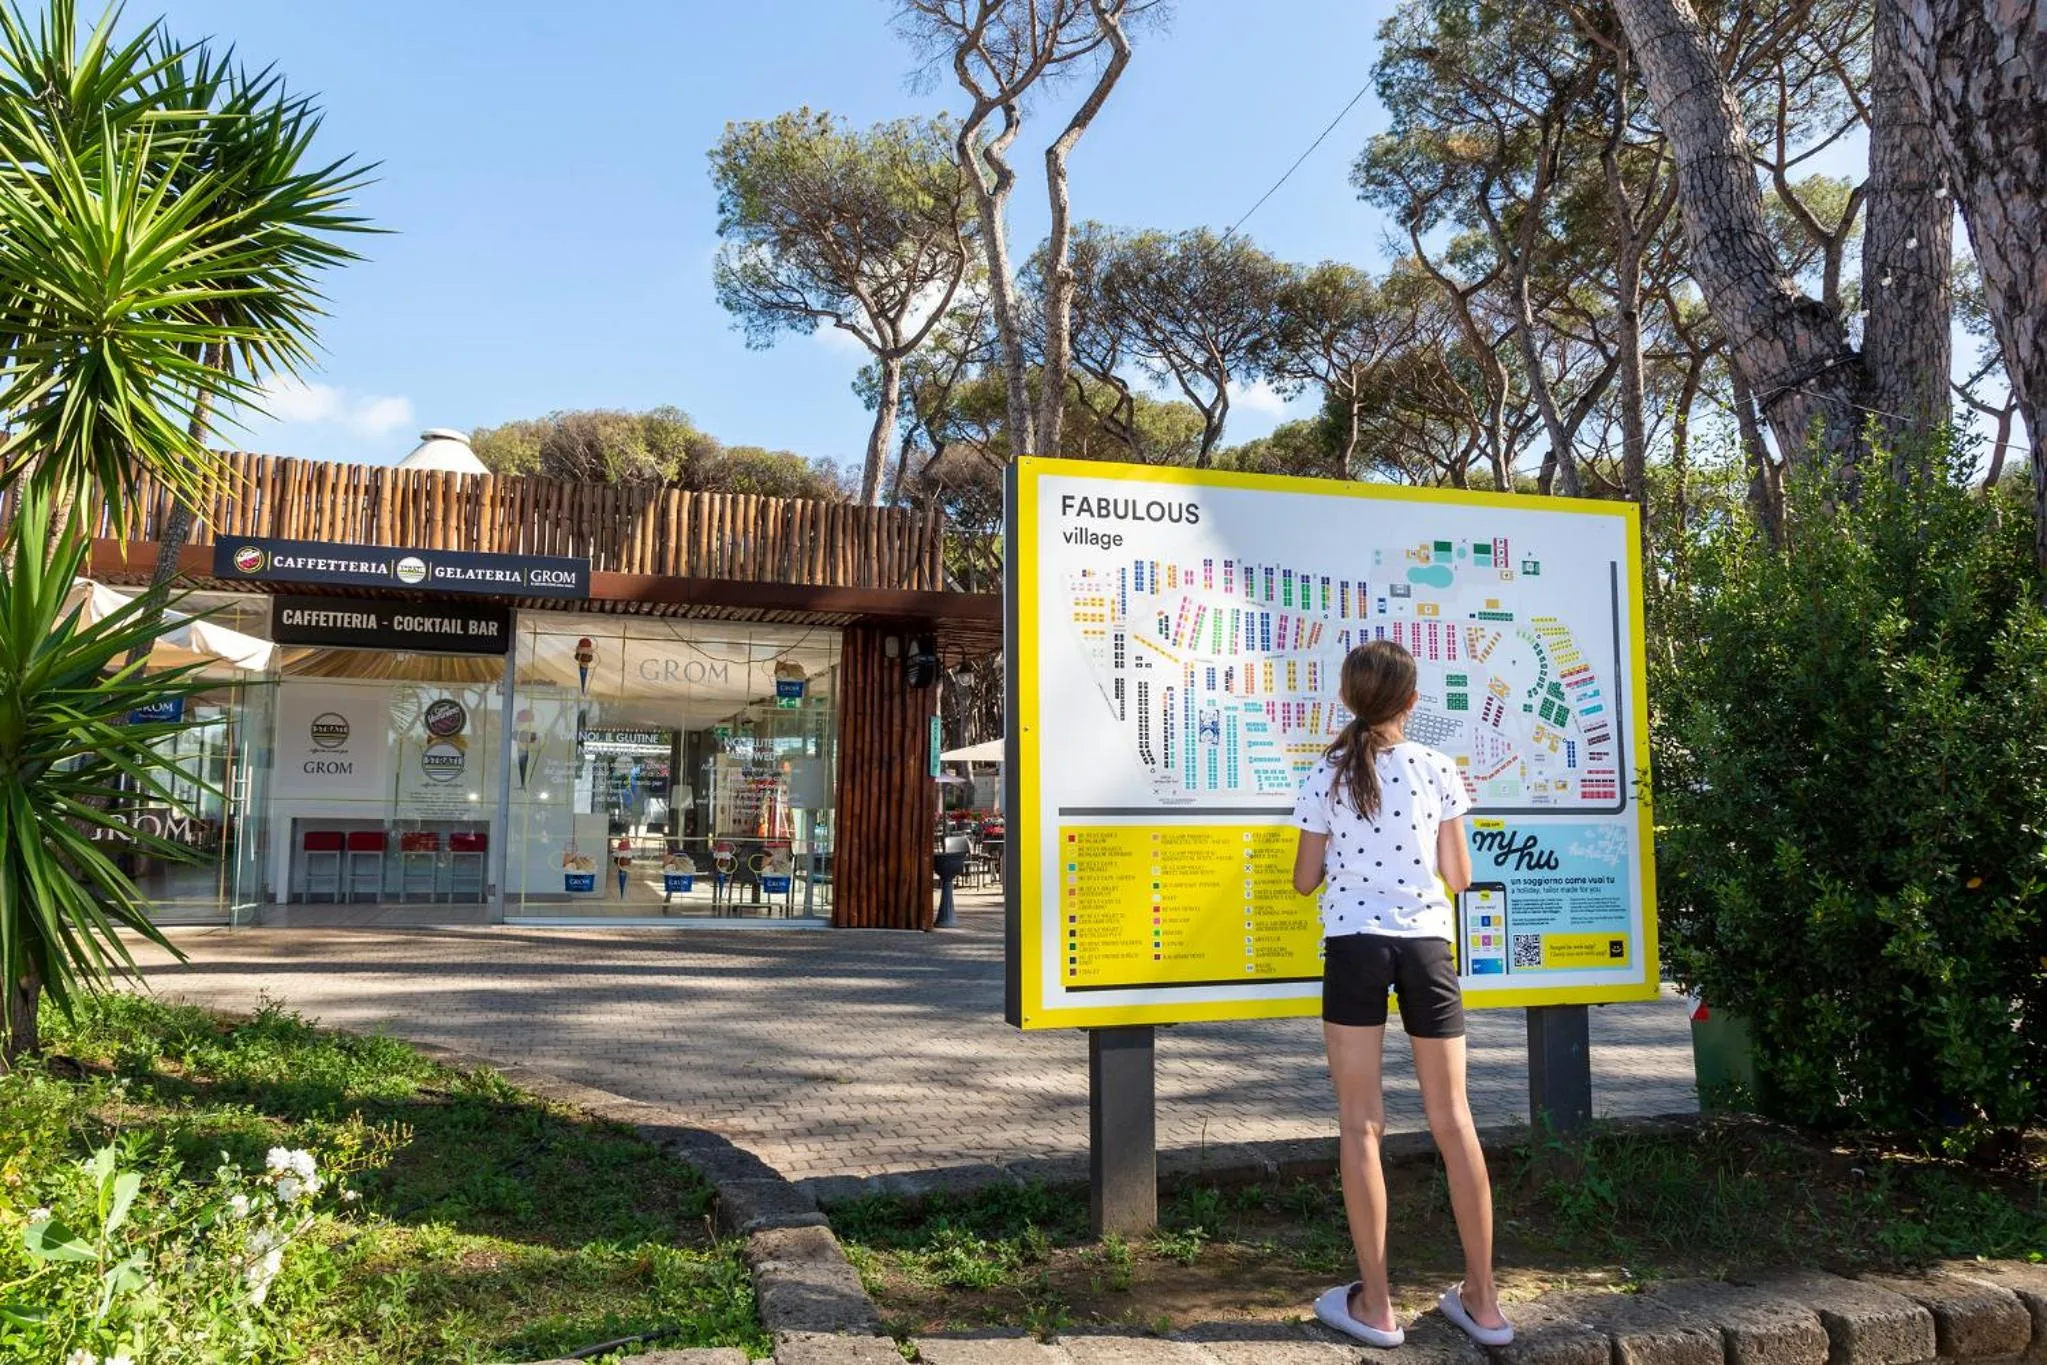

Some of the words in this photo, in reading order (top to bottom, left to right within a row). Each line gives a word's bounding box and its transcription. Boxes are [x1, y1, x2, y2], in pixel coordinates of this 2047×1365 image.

[1062, 495, 1200, 525] FABULOUS
[1063, 527, 1123, 550] village
[274, 556, 388, 574] CAFFETTERIA
[435, 567, 522, 583] GELATERIA
[530, 569, 576, 584] GROM
[282, 609, 377, 630] CAFFETTERIA
[393, 615, 464, 635] COCKTAIL
[468, 619, 498, 636] BAR
[639, 658, 729, 685] GROM
[616, 732, 659, 744] GLUTINE
[303, 760, 353, 775] GROM
